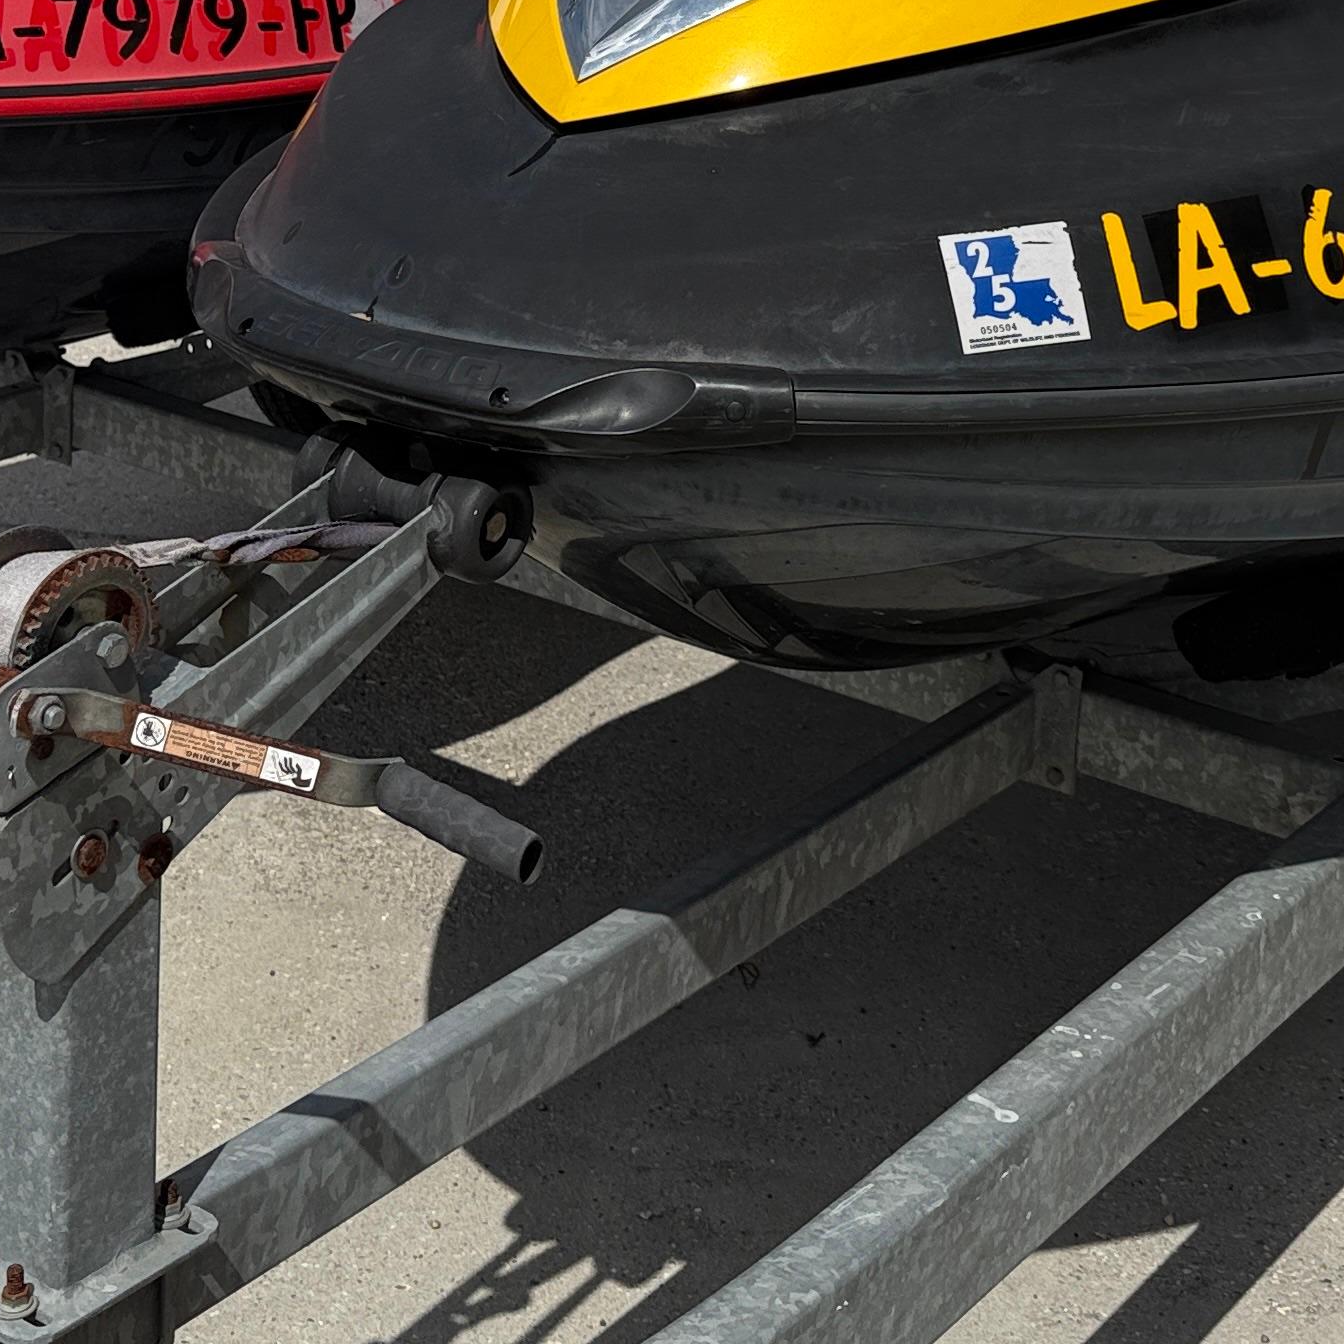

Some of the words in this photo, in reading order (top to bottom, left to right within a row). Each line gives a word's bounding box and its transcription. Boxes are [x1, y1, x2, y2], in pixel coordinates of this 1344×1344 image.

[966, 241, 994, 278] 2
[992, 274, 1017, 312] 5
[980, 323, 1018, 335] 050504
[185, 750, 232, 768] WARNING
